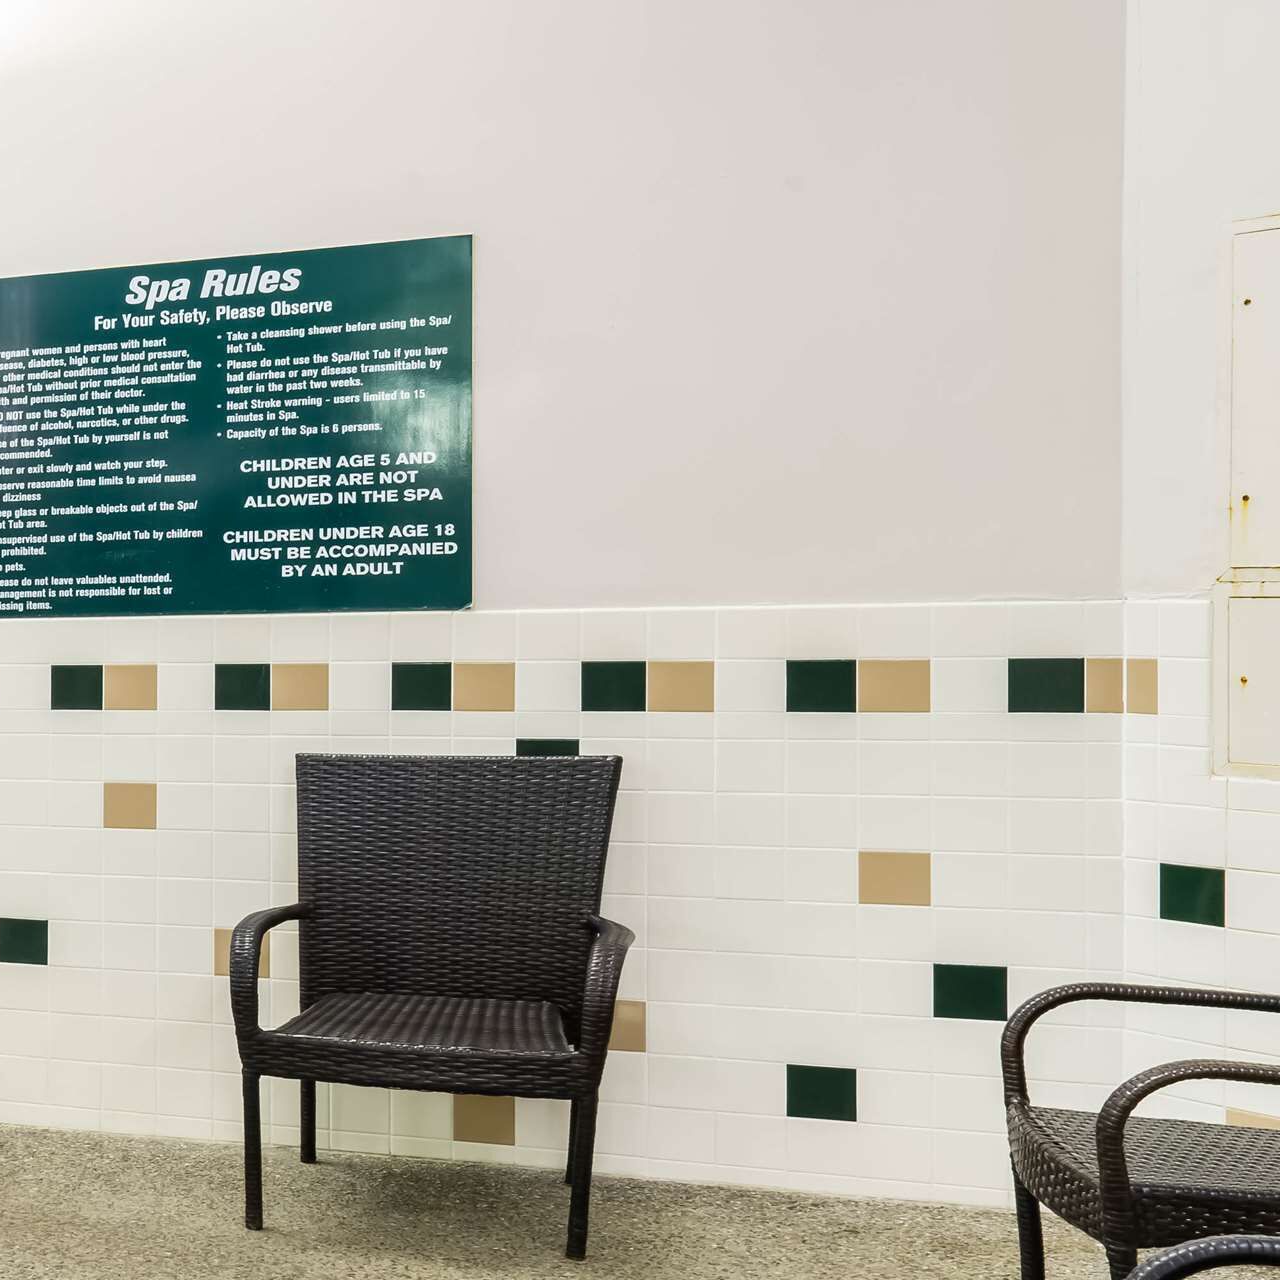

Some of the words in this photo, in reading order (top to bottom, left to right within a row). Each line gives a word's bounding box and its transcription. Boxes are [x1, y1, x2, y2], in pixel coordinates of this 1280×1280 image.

[125, 276, 190, 310] Spa
[200, 265, 302, 298] Rules
[94, 315, 117, 330] For
[123, 312, 155, 328] Your
[160, 308, 210, 326] Safety,
[216, 304, 265, 321] Please
[271, 301, 332, 316] Observe
[227, 331, 248, 341] Take
[260, 327, 305, 338] cleansing
[307, 326, 342, 335] shower
[345, 323, 376, 332] before
[379, 320, 406, 331] using
[409, 318, 425, 328] the
[428, 316, 451, 328] Spa/
[31, 347, 62, 356] women
[64, 344, 81, 353] and
[83, 343, 118, 354] persons
[120, 340, 140, 349] with
[142, 339, 166, 348] heart
[226, 344, 242, 354] Hot
[246, 342, 265, 352] Tub.
[226, 360, 257, 369] Please
[260, 358, 271, 367] do
[274, 357, 290, 366] not
[292, 357, 310, 365] use
[312, 354, 328, 364] the
[331, 352, 369, 364] Spa/Hot
[373, 350, 390, 359] Tub
[393, 349, 401, 358] if
[403, 349, 421, 360] you
[424, 347, 447, 356] have
[226, 372, 243, 382] had
[246, 370, 285, 381] diarrhea
[301, 369, 318, 379] any
[320, 367, 357, 376] disease
[360, 361, 426, 374] transmittable
[429, 360, 441, 371] by
[27, 383, 42, 392] Tub
[45, 381, 77, 391] without
[80, 380, 101, 391] prior
[103, 377, 138, 387] medical
[140, 373, 196, 384] consultation
[226, 385, 253, 394] water
[255, 384, 264, 393] in
[267, 383, 283, 392] the
[286, 381, 306, 393] past
[309, 381, 327, 389] two
[330, 378, 363, 388] weeks.
[226, 401, 248, 410] Heat
[250, 399, 281, 409] Stroke
[284, 397, 322, 407] warning
[333, 395, 360, 404] users
[363, 391, 397, 402] limited
[399, 391, 410, 400] to
[414, 390, 425, 399] 15
[5, 411, 22, 420] NOT
[43, 409, 57, 418] the
[60, 407, 94, 419] Spa/Hot
[98, 406, 113, 415] Tub
[115, 404, 139, 414] while
[142, 403, 168, 412] under
[170, 402, 185, 410] the
[226, 413, 263, 423] minutes
[266, 412, 275, 421] in
[278, 411, 299, 422] Spa.
[226, 428, 266, 440] Capacity
[269, 427, 278, 437] of
[281, 427, 296, 436] the
[299, 426, 318, 437] Spa
[320, 425, 329, 434] is
[332, 424, 338, 433] 6
[341, 424, 382, 435] persons.
[27, 465, 43, 474] exit
[46, 463, 73, 474] slowly
[75, 462, 91, 471] and
[94, 461, 121, 470] watch
[123, 461, 143, 471] your
[145, 459, 167, 469] step.
[239, 456, 331, 472] CHILDREN
[336, 454, 375, 468] AGE
[380, 454, 390, 466] 5
[395, 451, 436, 465] AND
[267, 475, 331, 489] UNDER
[335, 473, 374, 486] ARE
[379, 471, 416, 484] NOT
[2, 493, 41, 502] dizziness
[244, 492, 333, 508] ALLOWED
[337, 491, 356, 504] IN
[361, 489, 398, 503] THE
[403, 488, 442, 501] SPA
[14, 508, 37, 519] glass
[51, 506, 93, 515] breakable
[95, 505, 128, 515] objects
[130, 504, 145, 512] out
[147, 503, 156, 512] of
[159, 503, 174, 511] the
[176, 501, 197, 512] Spa/
[9, 520, 23, 529] Tub
[222, 528, 313, 543] CHILDREN
[318, 526, 383, 540] UNDER
[388, 524, 428, 538] AGE
[434, 523, 454, 536] 18
[67, 533, 76, 542] of
[79, 533, 93, 541] the
[96, 532, 130, 543] Spa/Hot
[134, 531, 150, 540] Tub
[152, 531, 163, 541] by
[165, 530, 202, 539] children
[1, 546, 46, 558] prohibited.
[230, 547, 282, 561] MUST
[286, 546, 311, 559] BE
[315, 542, 457, 558] ACCOMPANIED
[4, 563, 25, 573] pets.
[281, 564, 305, 577] BY
[311, 564, 337, 576] AN
[342, 562, 403, 575] ADULT
[21, 577, 32, 586] do
[34, 577, 48, 585] not
[50, 577, 73, 585] leave
[75, 575, 117, 584] valuables
[119, 574, 171, 583] unattended.
[48, 589, 56, 598] is
[58, 589, 73, 597] not
[75, 588, 125, 599] responsible
[128, 587, 141, 596] for
[143, 587, 160, 595] lost
[26, 601, 52, 610] items.
